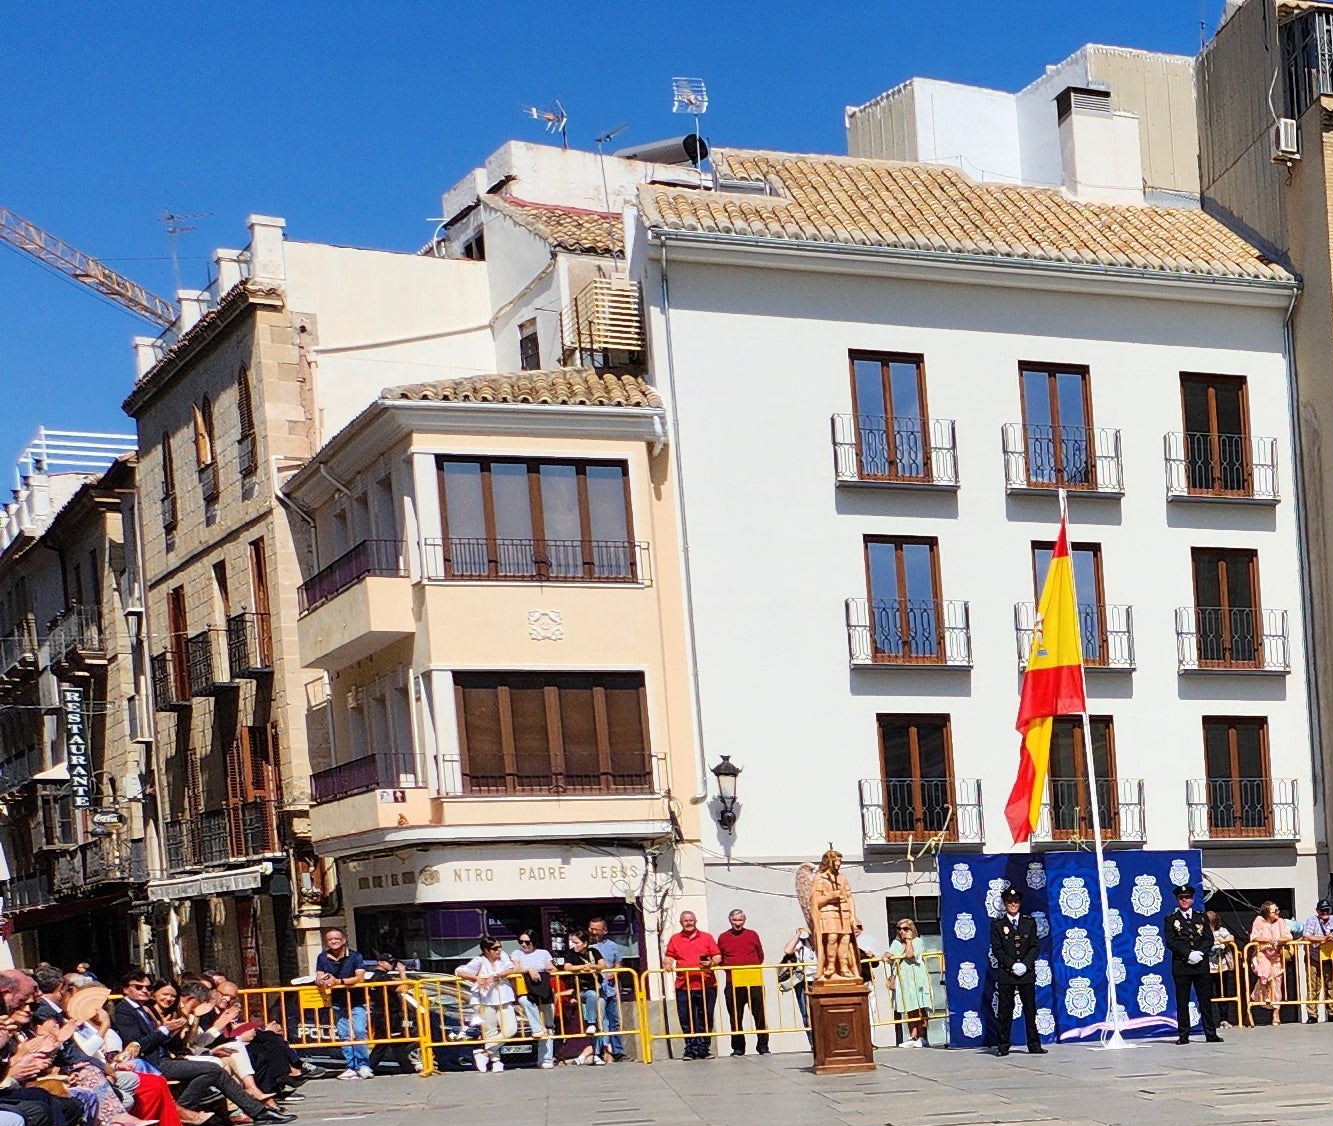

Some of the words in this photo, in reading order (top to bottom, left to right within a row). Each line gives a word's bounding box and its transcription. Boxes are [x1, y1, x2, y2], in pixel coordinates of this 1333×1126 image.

[65, 691, 89, 806] RESTAURANTE
[453, 868, 494, 882] NTRO
[519, 866, 567, 881] PADRE
